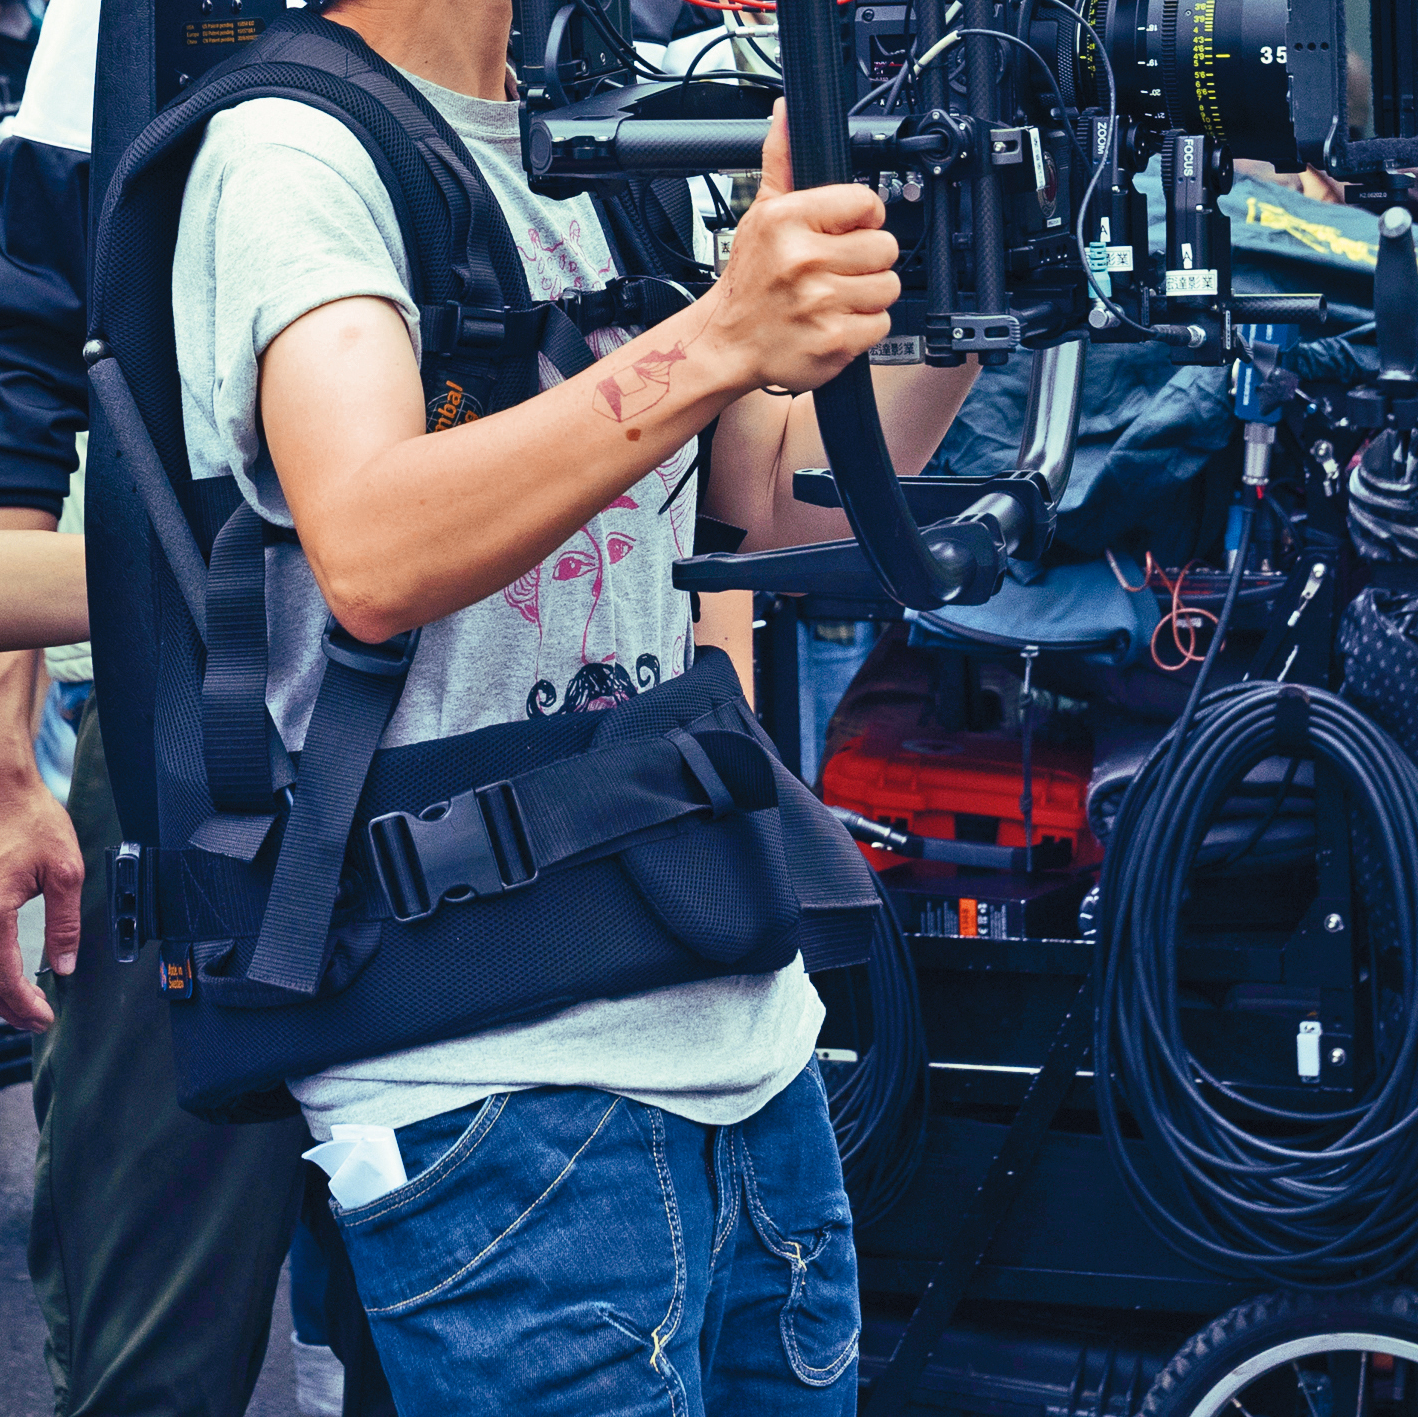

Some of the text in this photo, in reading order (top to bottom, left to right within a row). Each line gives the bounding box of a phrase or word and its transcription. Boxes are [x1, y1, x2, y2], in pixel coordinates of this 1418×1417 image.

[1193, 52, 1205, 60] 4'9
[1260, 46, 1288, 64] 35
[1194, 71, 1206, 79] 5'6
[1097, 122, 1107, 155] ZOOM
[1183, 138, 1194, 177] FOCUS
[1101, 225, 1108, 235] A
[1183, 251, 1192, 262] A
